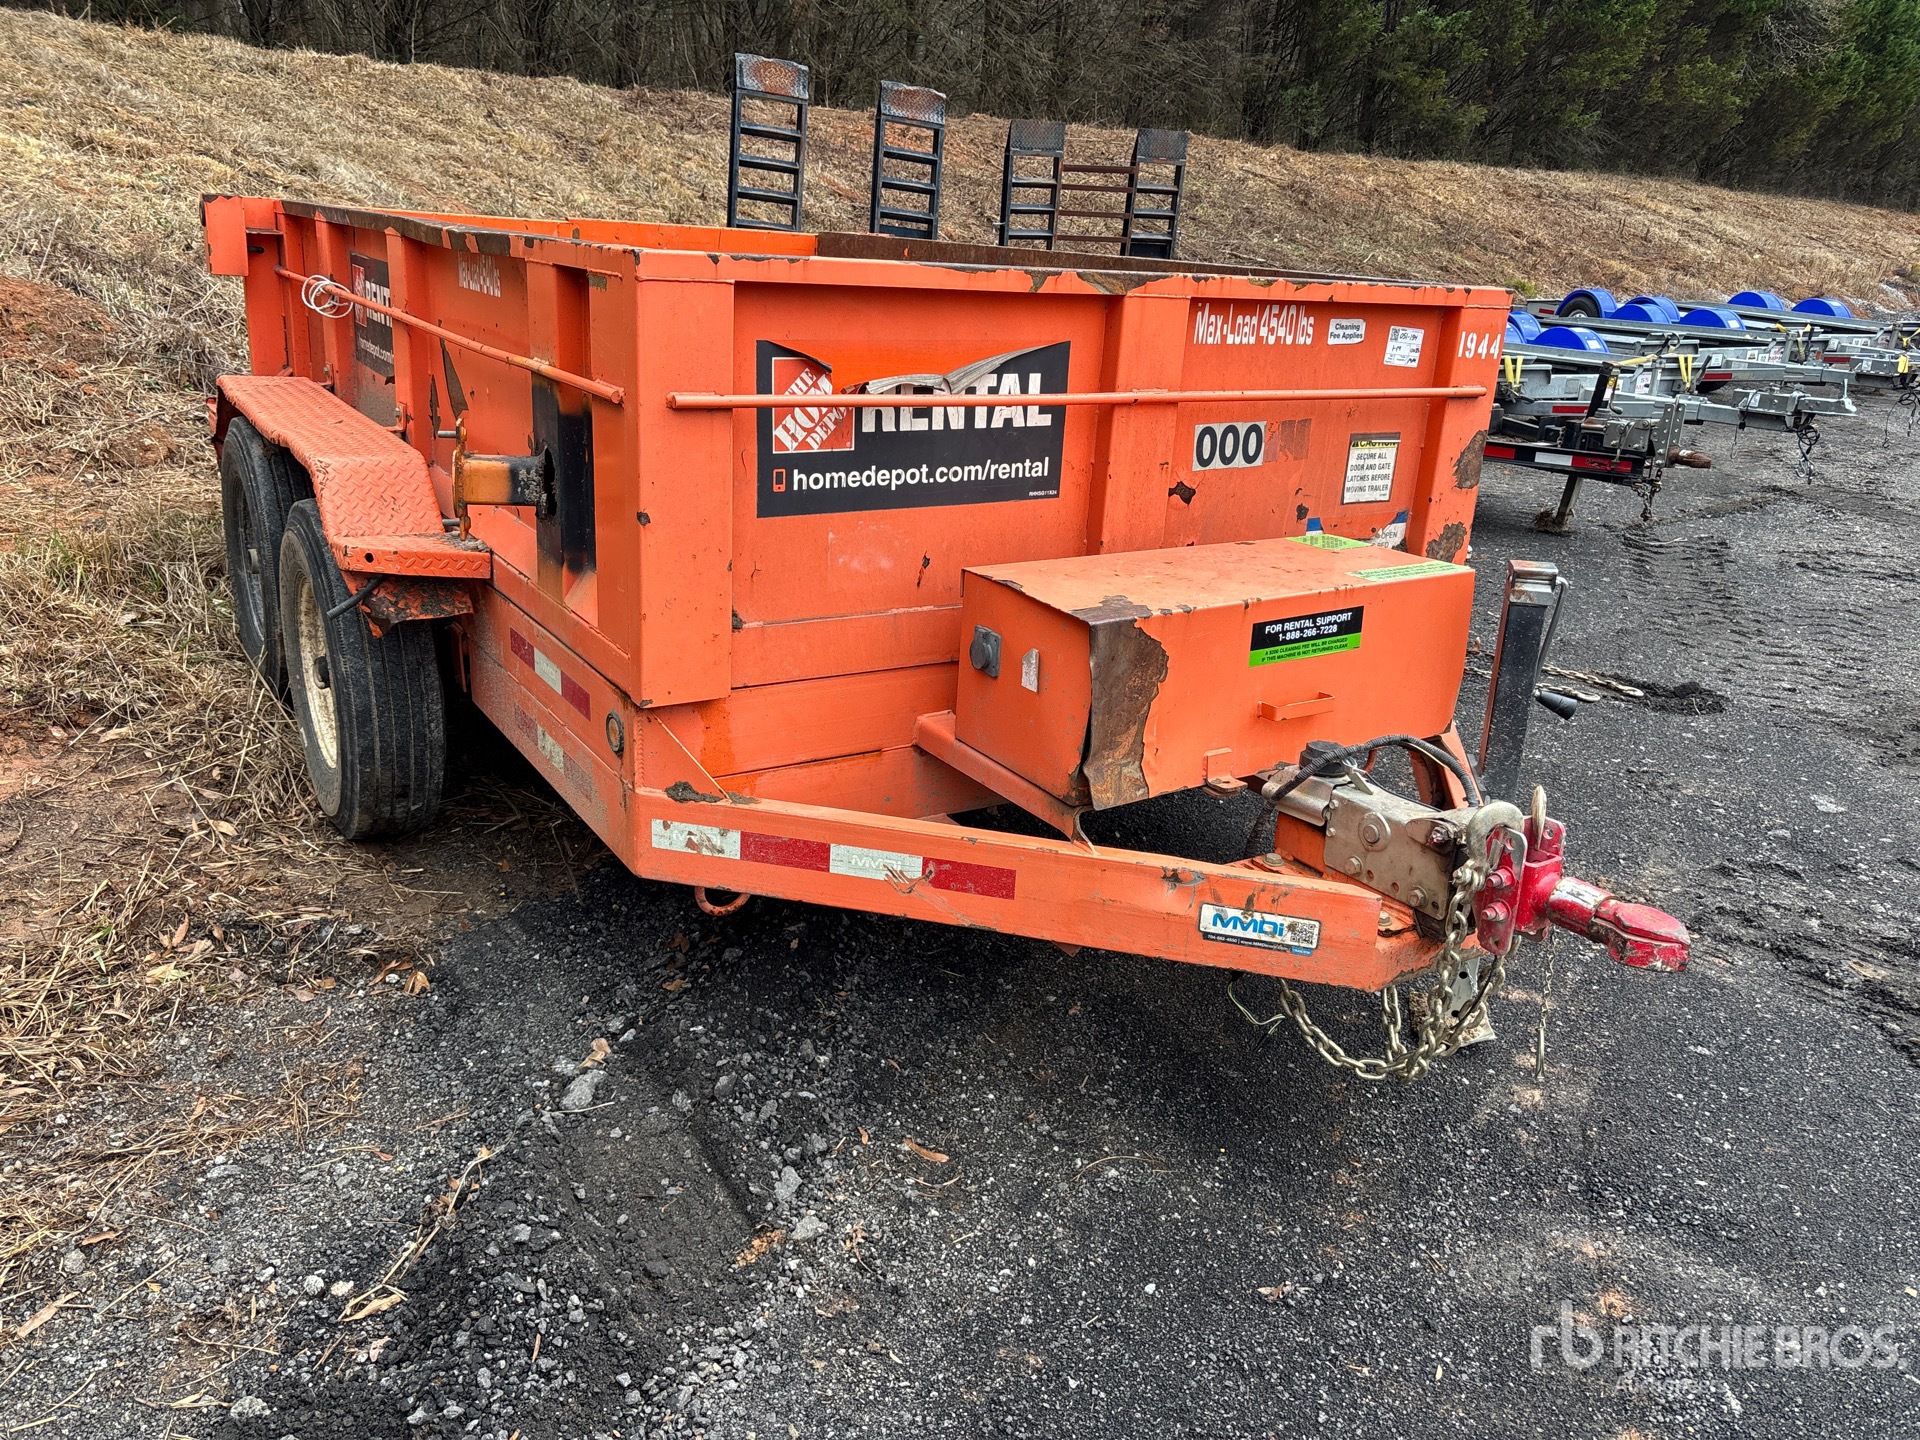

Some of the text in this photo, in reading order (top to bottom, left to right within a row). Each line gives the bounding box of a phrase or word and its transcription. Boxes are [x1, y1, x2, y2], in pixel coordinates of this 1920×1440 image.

[365, 280, 393, 327] RENT
[1193, 302, 1315, 345] Max-Load 4540 lbs
[1335, 323, 1360, 331] Cleaning
[1342, 332, 1363, 340] Applies
[1458, 331, 1501, 360] 1944
[862, 373, 1052, 433] RENTAL
[1196, 423, 1263, 467] 000
[792, 457, 1050, 491] homedepot.com/rental
[1377, 462, 1391, 470] GATE
[1370, 473, 1391, 481] BEFORE
[1381, 531, 1398, 539] OPEN
[1265, 612, 1353, 634] FOR RENTAL SUPPORT
[1278, 624, 1338, 641] 1-888-266-7228
[1276, 652, 1297, 660] MACHINE
[1311, 646, 1334, 654] RETURNED
[1280, 645, 1301, 653] CLEANING
[1327, 637, 1349, 645] CHARGED
